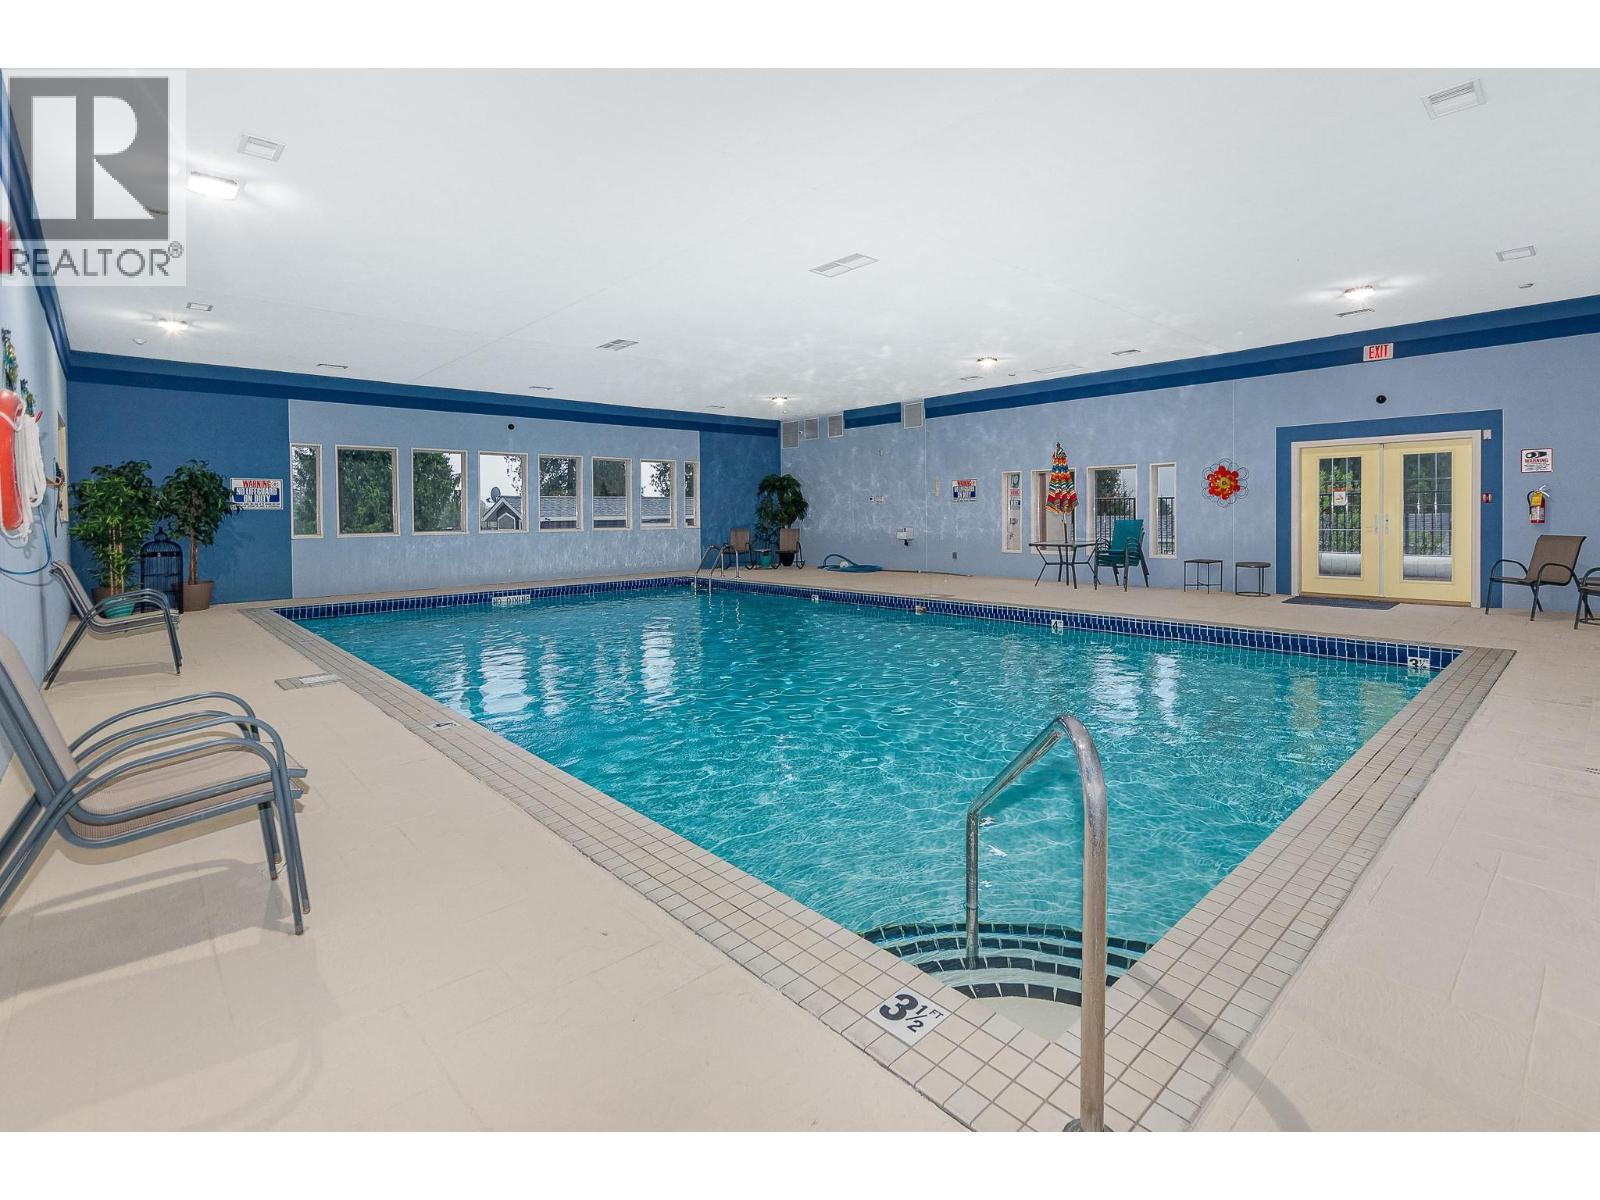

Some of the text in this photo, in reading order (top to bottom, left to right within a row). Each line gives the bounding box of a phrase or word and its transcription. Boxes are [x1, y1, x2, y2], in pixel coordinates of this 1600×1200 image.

[1368, 345, 1389, 359] EXIT
[242, 480, 271, 488] WARNING
[928, 1008, 944, 1019] FT
